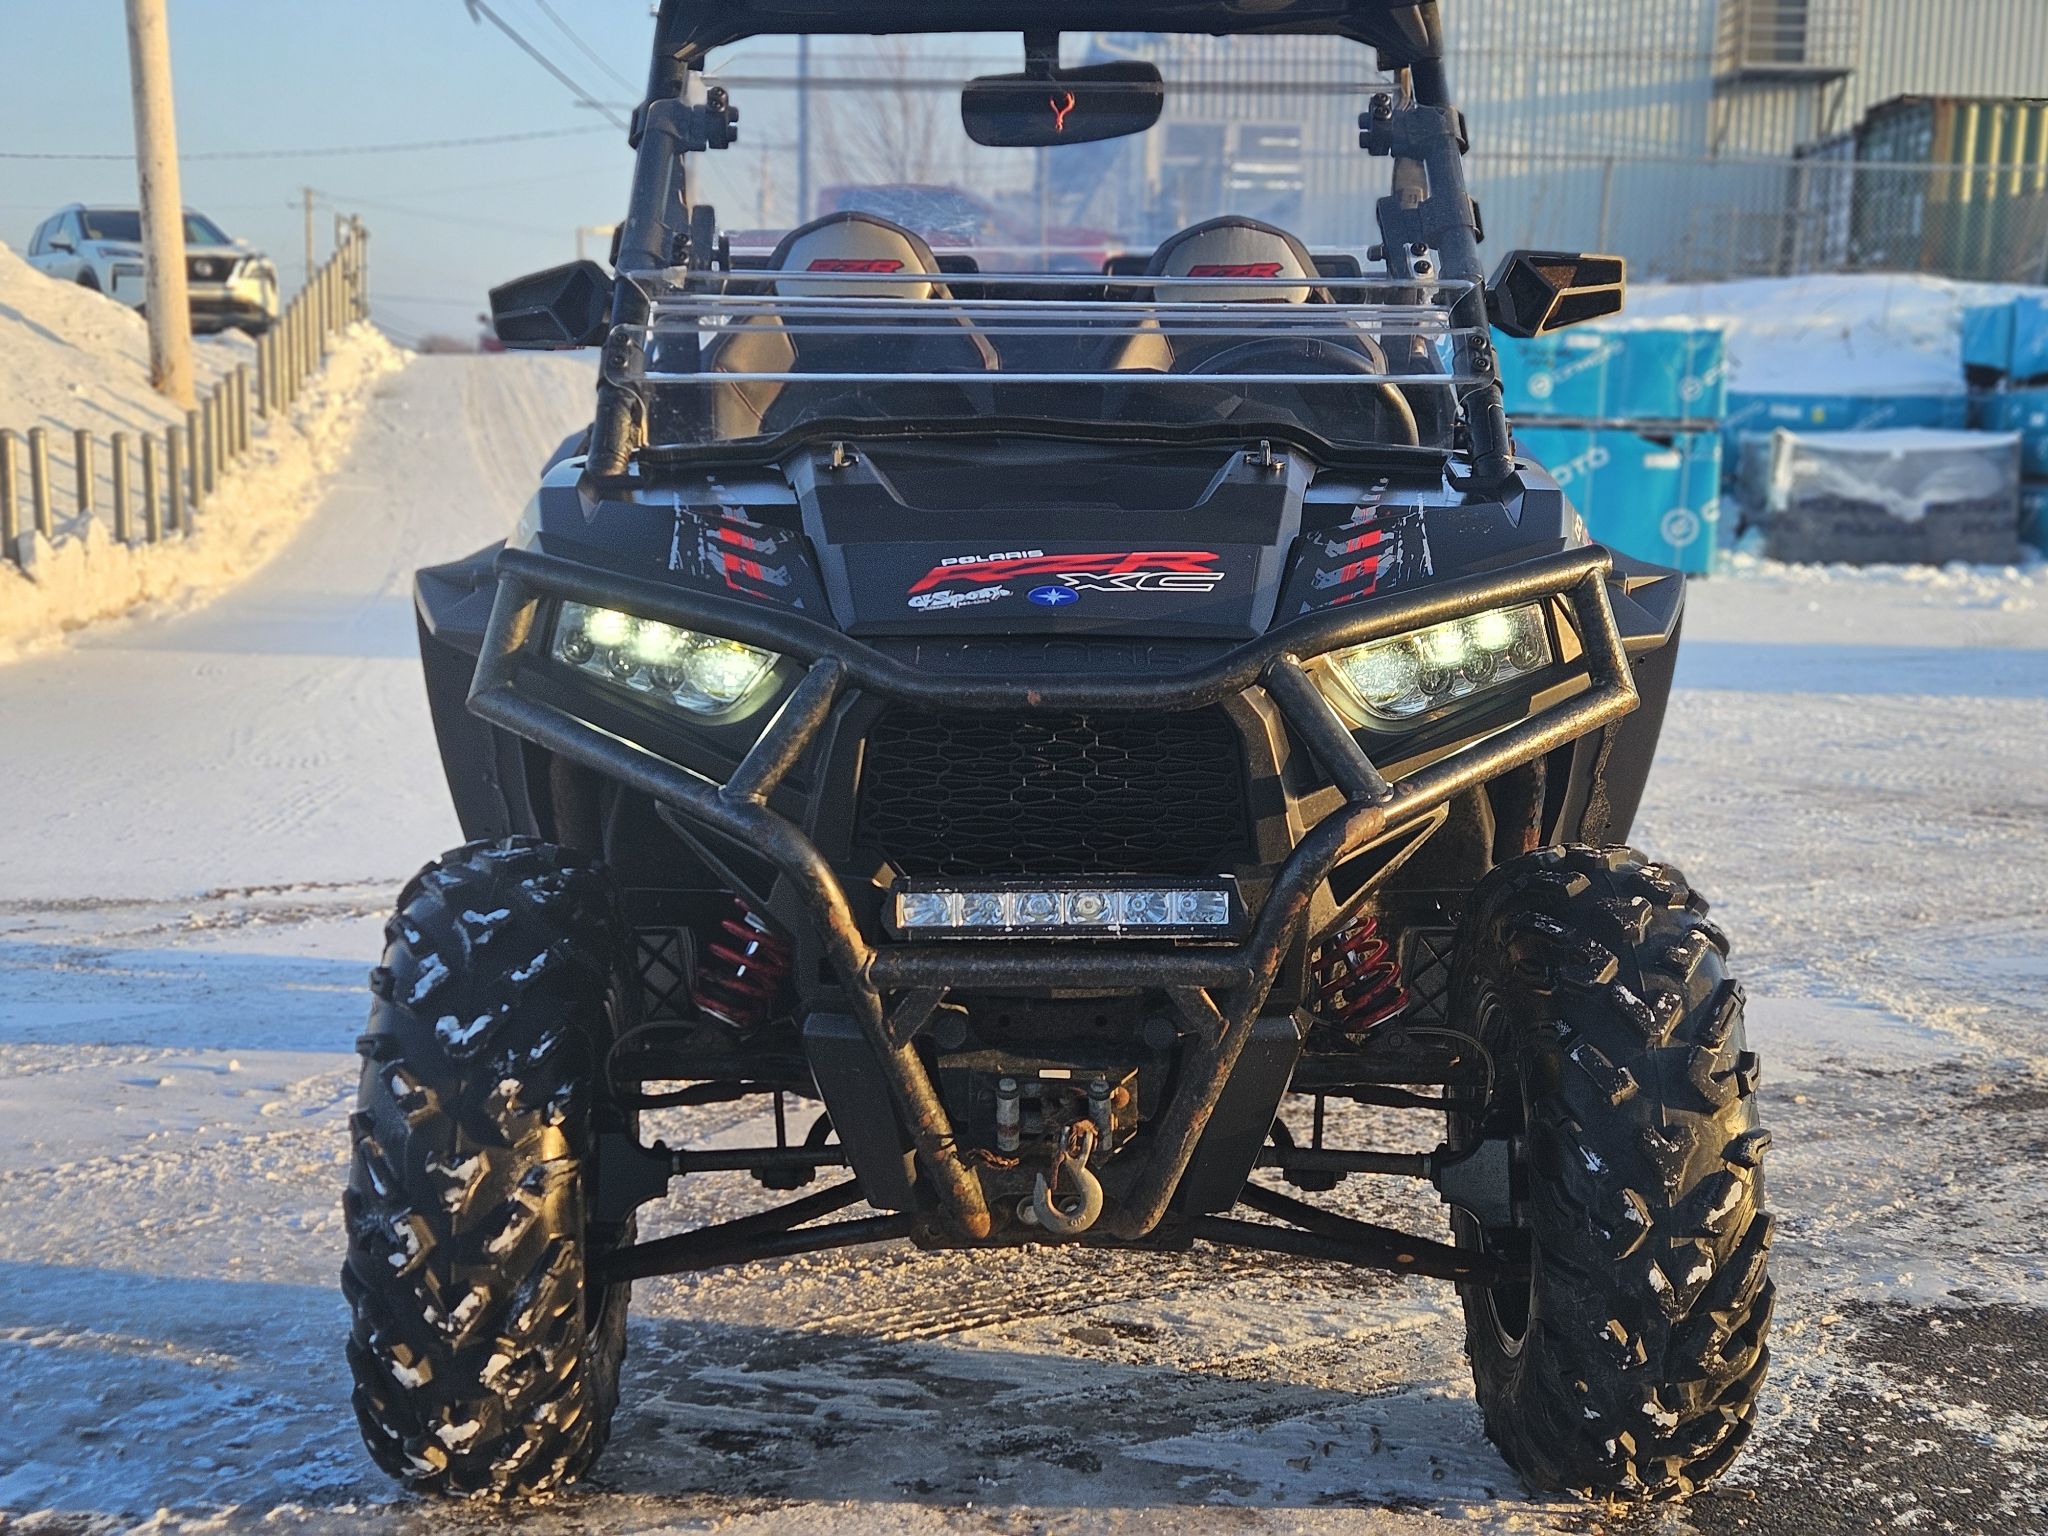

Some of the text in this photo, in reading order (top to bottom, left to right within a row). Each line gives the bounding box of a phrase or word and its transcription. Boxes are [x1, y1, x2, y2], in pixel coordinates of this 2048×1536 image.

[941, 549, 1044, 567] POLARIS
[907, 551, 1220, 594] RZR
[1056, 572, 1225, 592] XC
